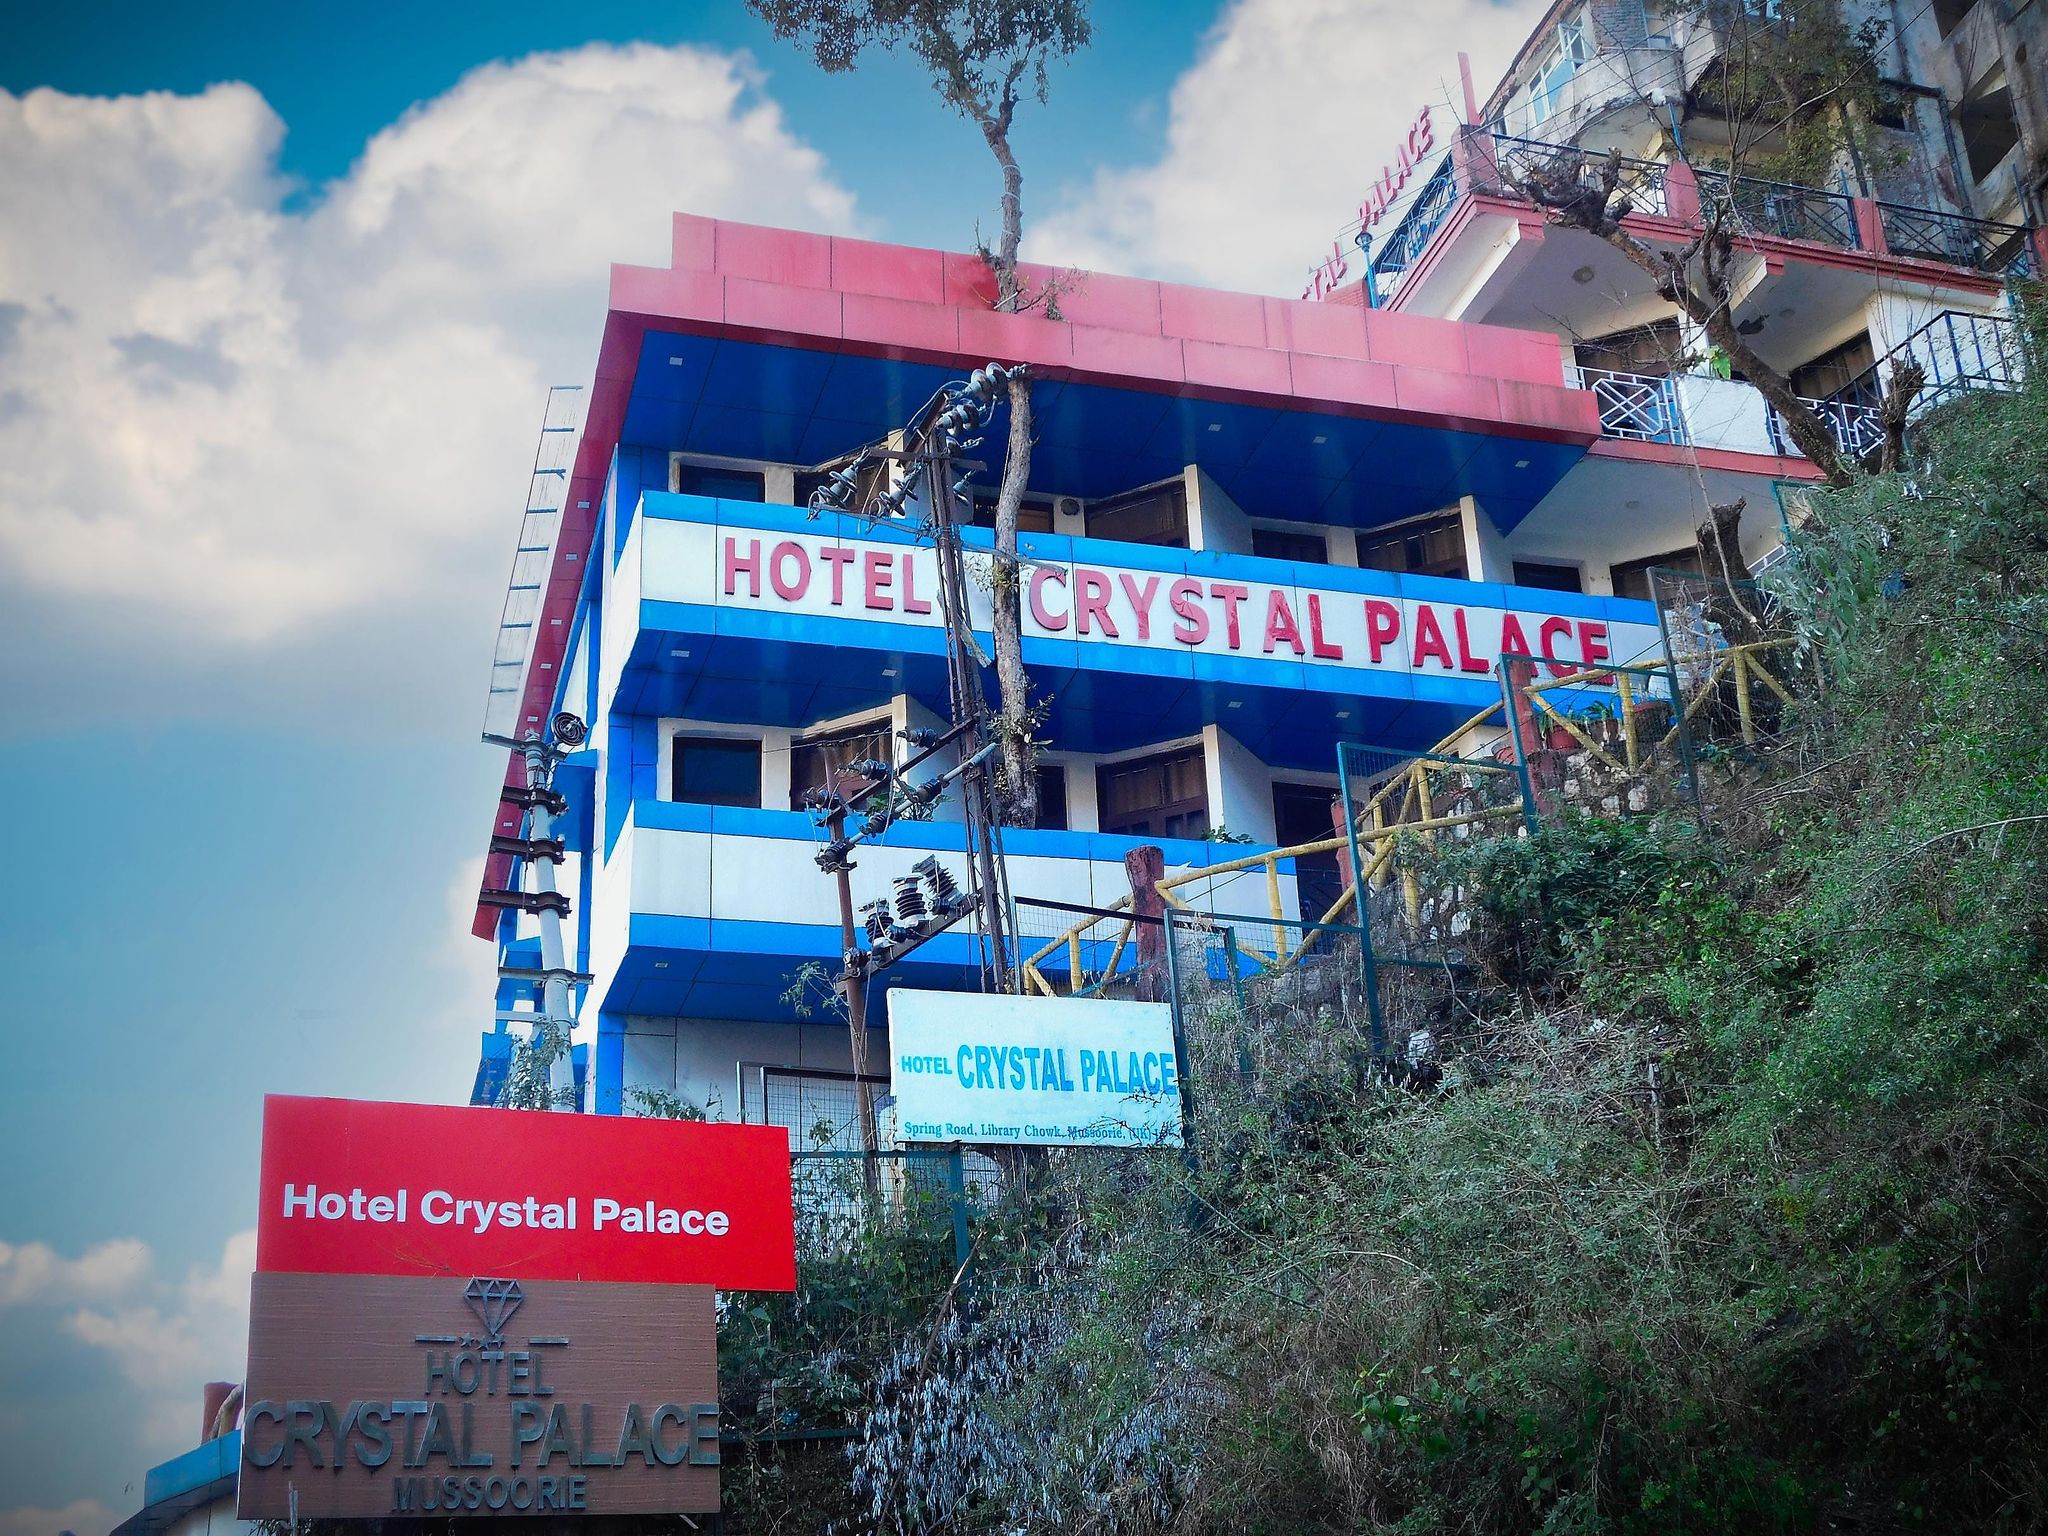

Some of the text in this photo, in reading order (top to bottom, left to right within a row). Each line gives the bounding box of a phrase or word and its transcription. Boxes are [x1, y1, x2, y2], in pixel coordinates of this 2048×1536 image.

[1359, 104, 1433, 232] PALACE
[724, 537, 1615, 686] HOTEL CRYSTAL PALACE
[901, 1044, 1178, 1096] HOTEL CRYSTAL PALACE
[904, 1121, 942, 1139] Spring
[945, 1123, 977, 1136] Road,
[981, 1123, 1020, 1140] Library
[1067, 1126, 1126, 1139] Mussoorie,
[283, 1183, 730, 1236] Hotel Crystal Palace
[425, 1350, 555, 1395] HOTEL
[244, 1401, 721, 1468] CRYSTAL PALACE
[391, 1475, 588, 1511] MUSSOORIE
